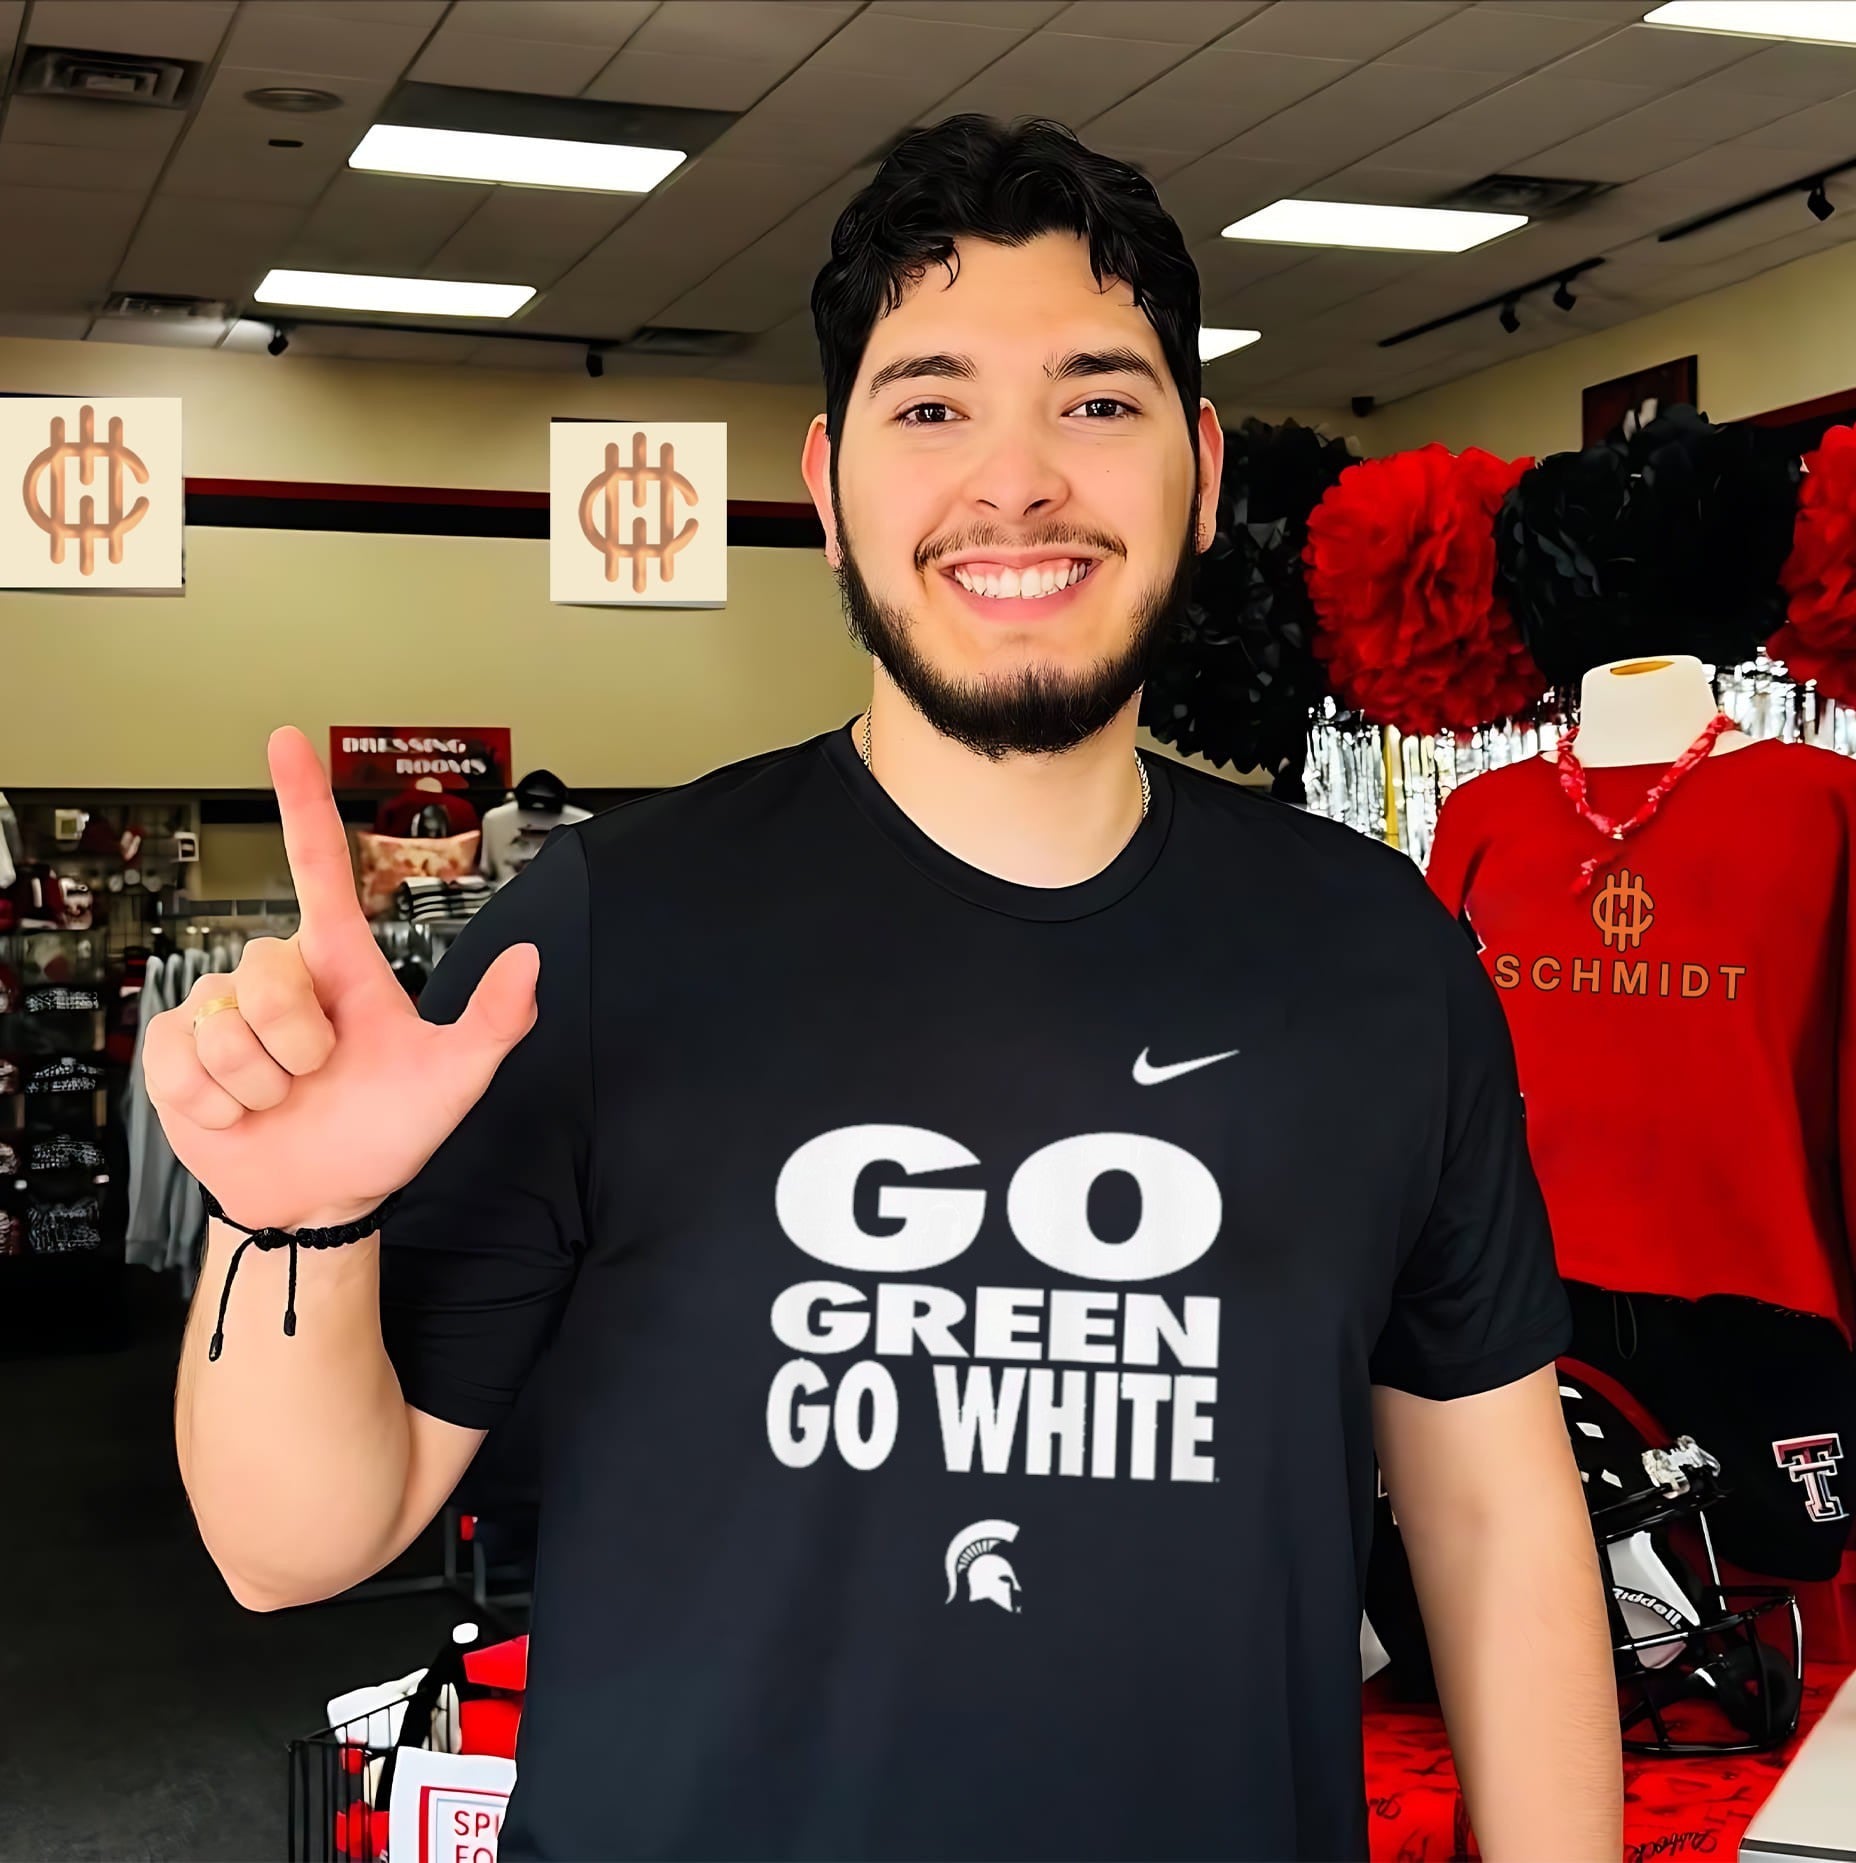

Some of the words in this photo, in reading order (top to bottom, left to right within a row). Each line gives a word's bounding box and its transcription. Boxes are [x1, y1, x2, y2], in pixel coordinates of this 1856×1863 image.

[342, 737, 467, 754] DRESSING
[396, 758, 487, 775] ROOMS
[1494, 953, 1747, 1001] SCHMIDT
[775, 1124, 1223, 1282] GO
[770, 1280, 1221, 1369] GREEN
[766, 1358, 899, 1471] GO
[932, 1363, 1218, 1483] WHITE
